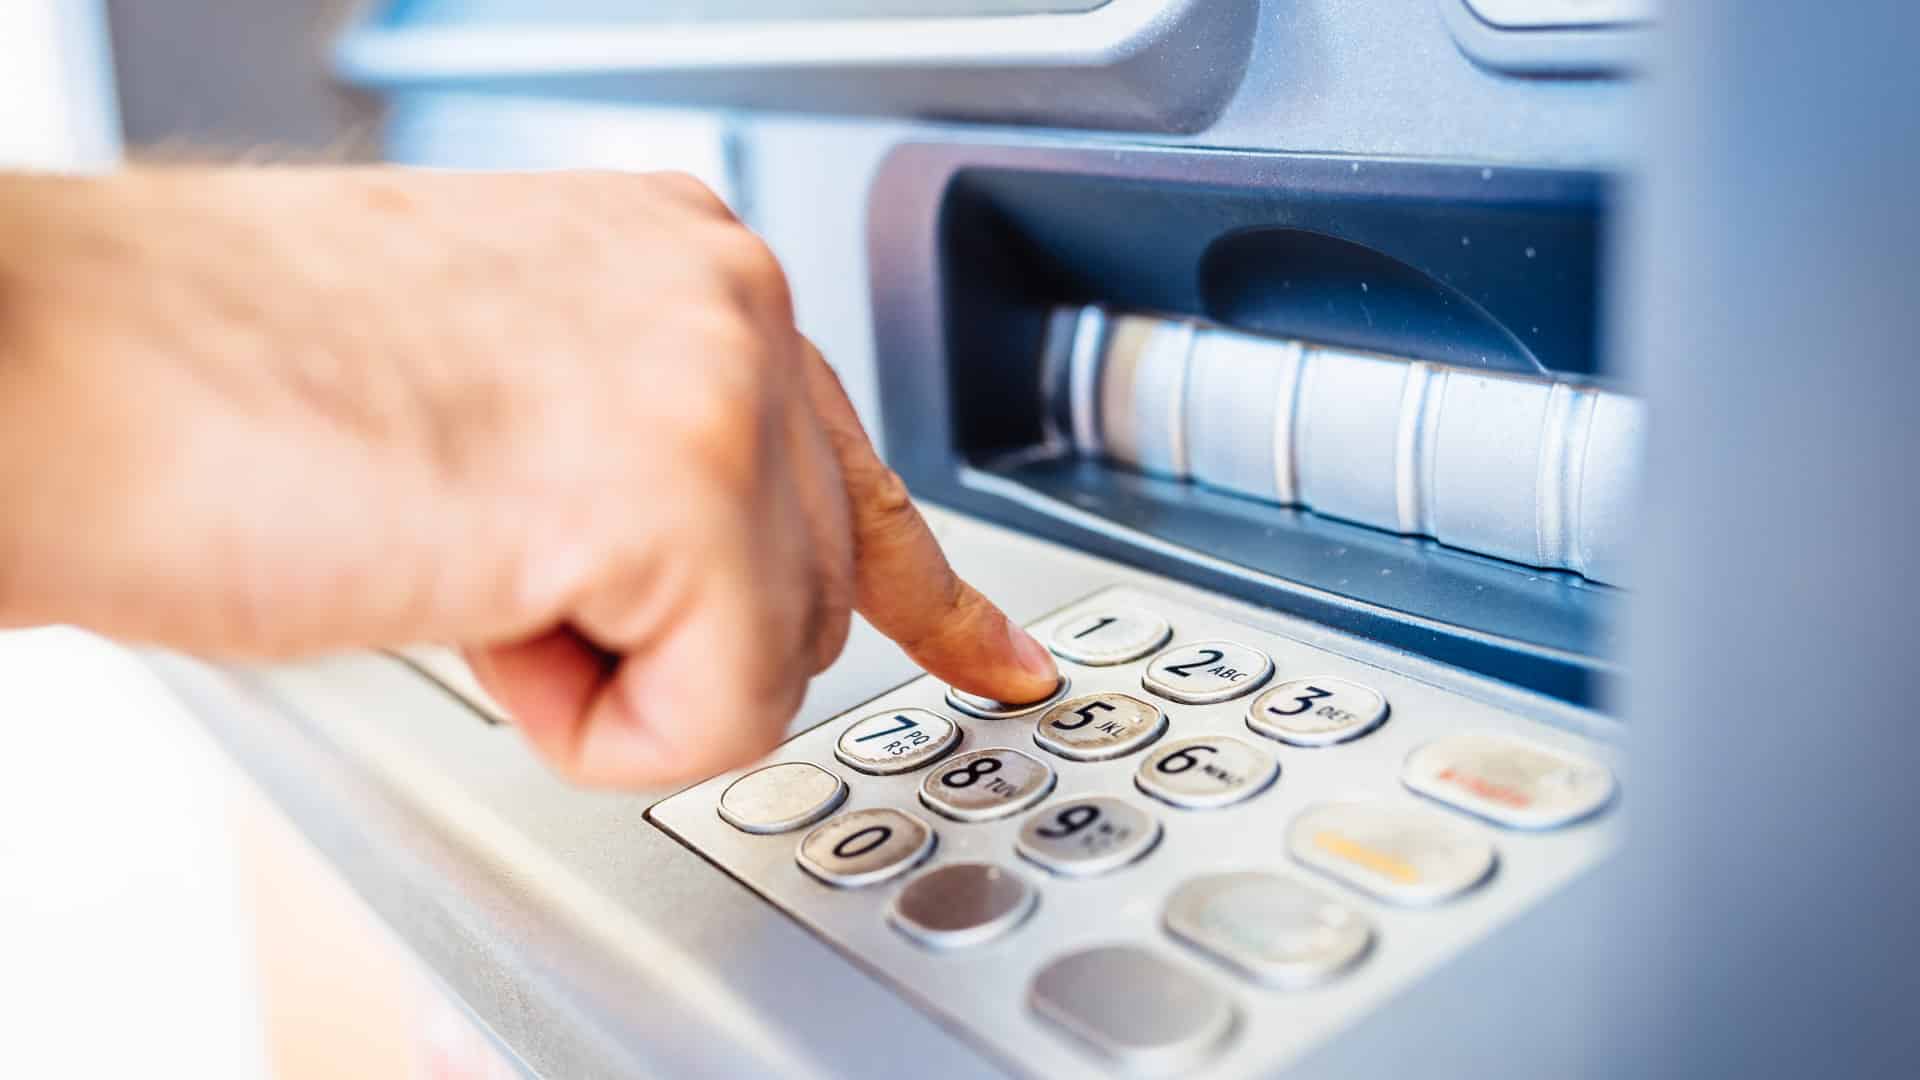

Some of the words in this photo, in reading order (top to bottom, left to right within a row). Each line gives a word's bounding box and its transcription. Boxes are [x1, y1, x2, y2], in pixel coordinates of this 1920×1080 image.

[1073, 617, 1117, 639] 1
[1163, 650, 1224, 677] 2
[1205, 664, 1249, 682] ABC
[1267, 686, 1334, 715] 3
[855, 715, 919, 743] 7
[904, 731, 931, 746] PQ
[1051, 701, 1116, 730] 5
[1094, 720, 1126, 738] JKL
[883, 740, 909, 757] RS
[1156, 746, 1218, 774] 6
[941, 757, 1002, 788] 8
[1036, 805, 1100, 838] 9
[832, 826, 892, 859] 0
